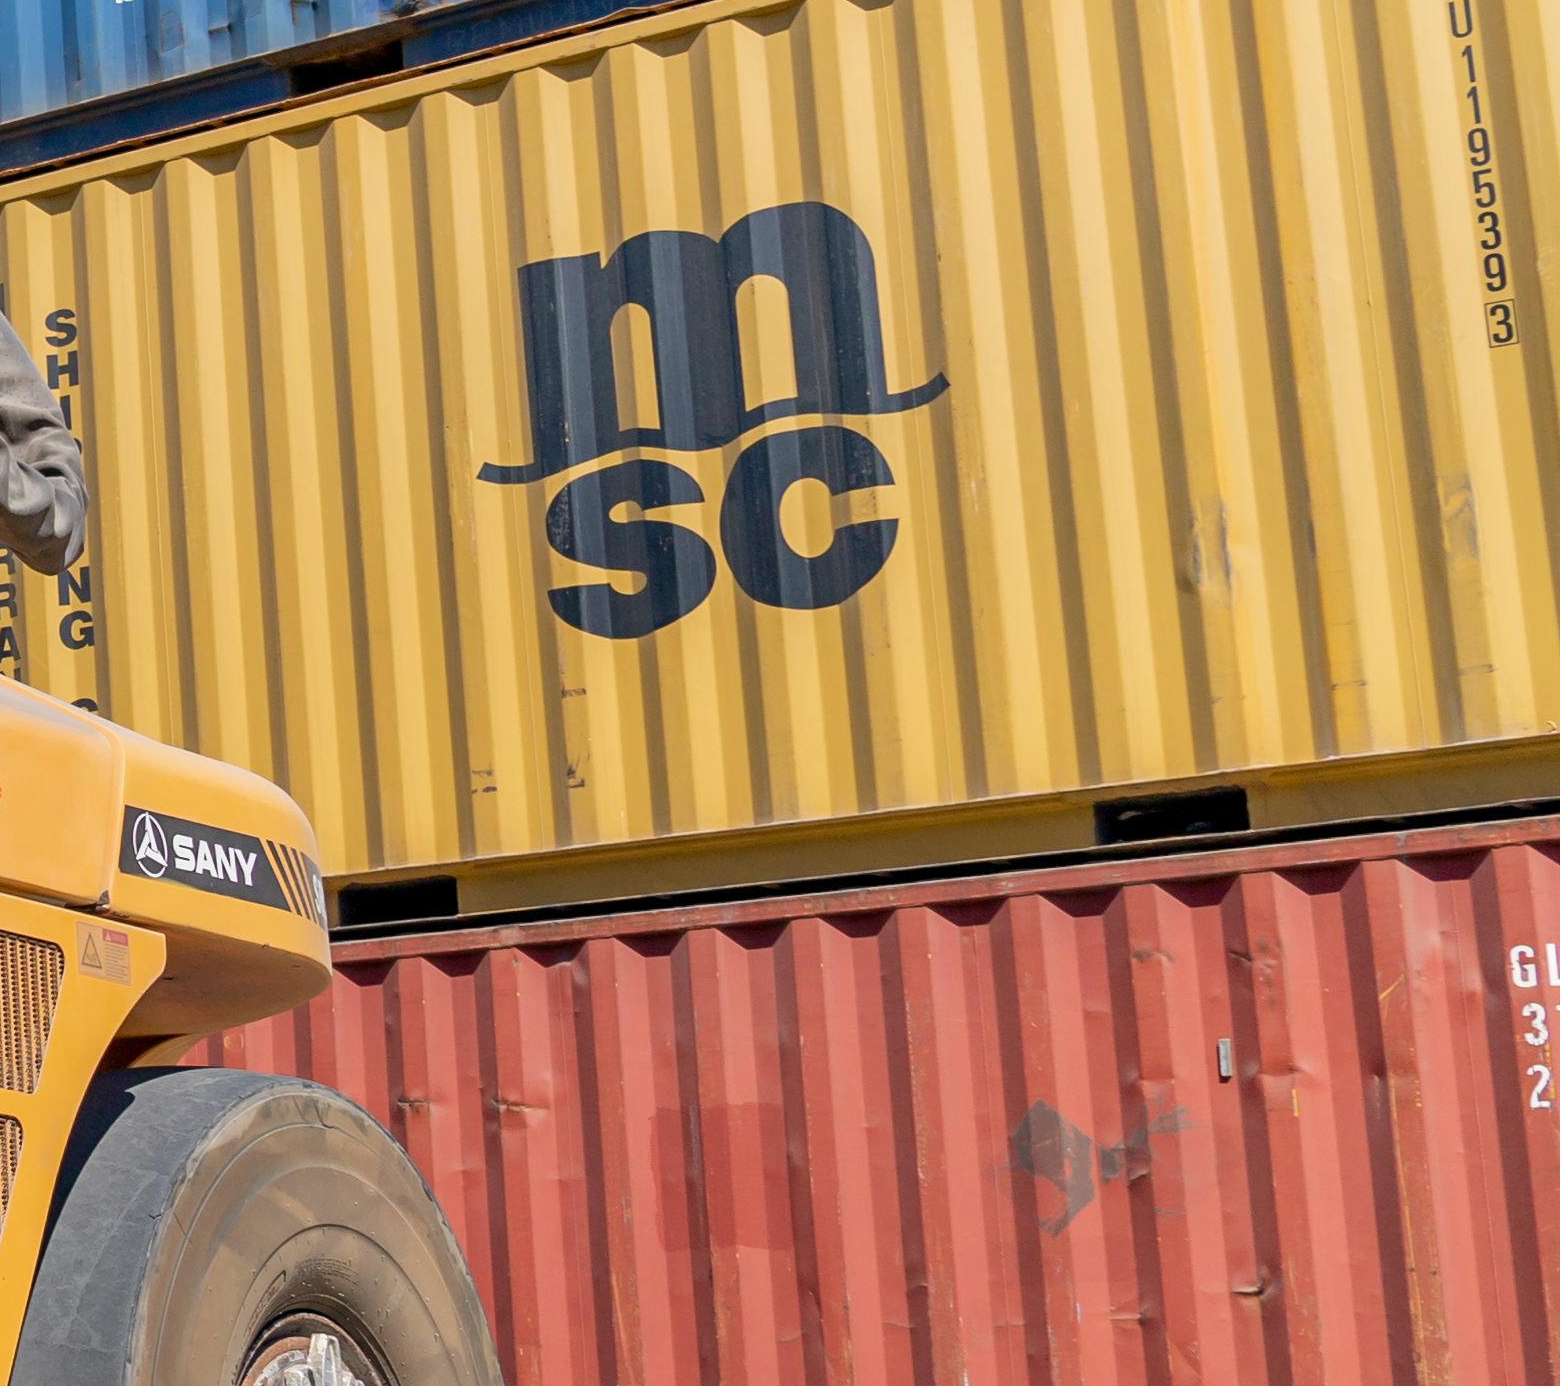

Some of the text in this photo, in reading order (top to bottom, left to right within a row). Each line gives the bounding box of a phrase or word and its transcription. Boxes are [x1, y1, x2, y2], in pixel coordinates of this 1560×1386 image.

[1460, 44, 1507, 293] 119539
[45, 308, 95, 651] SHING
[172, 833, 258, 887] SANY
